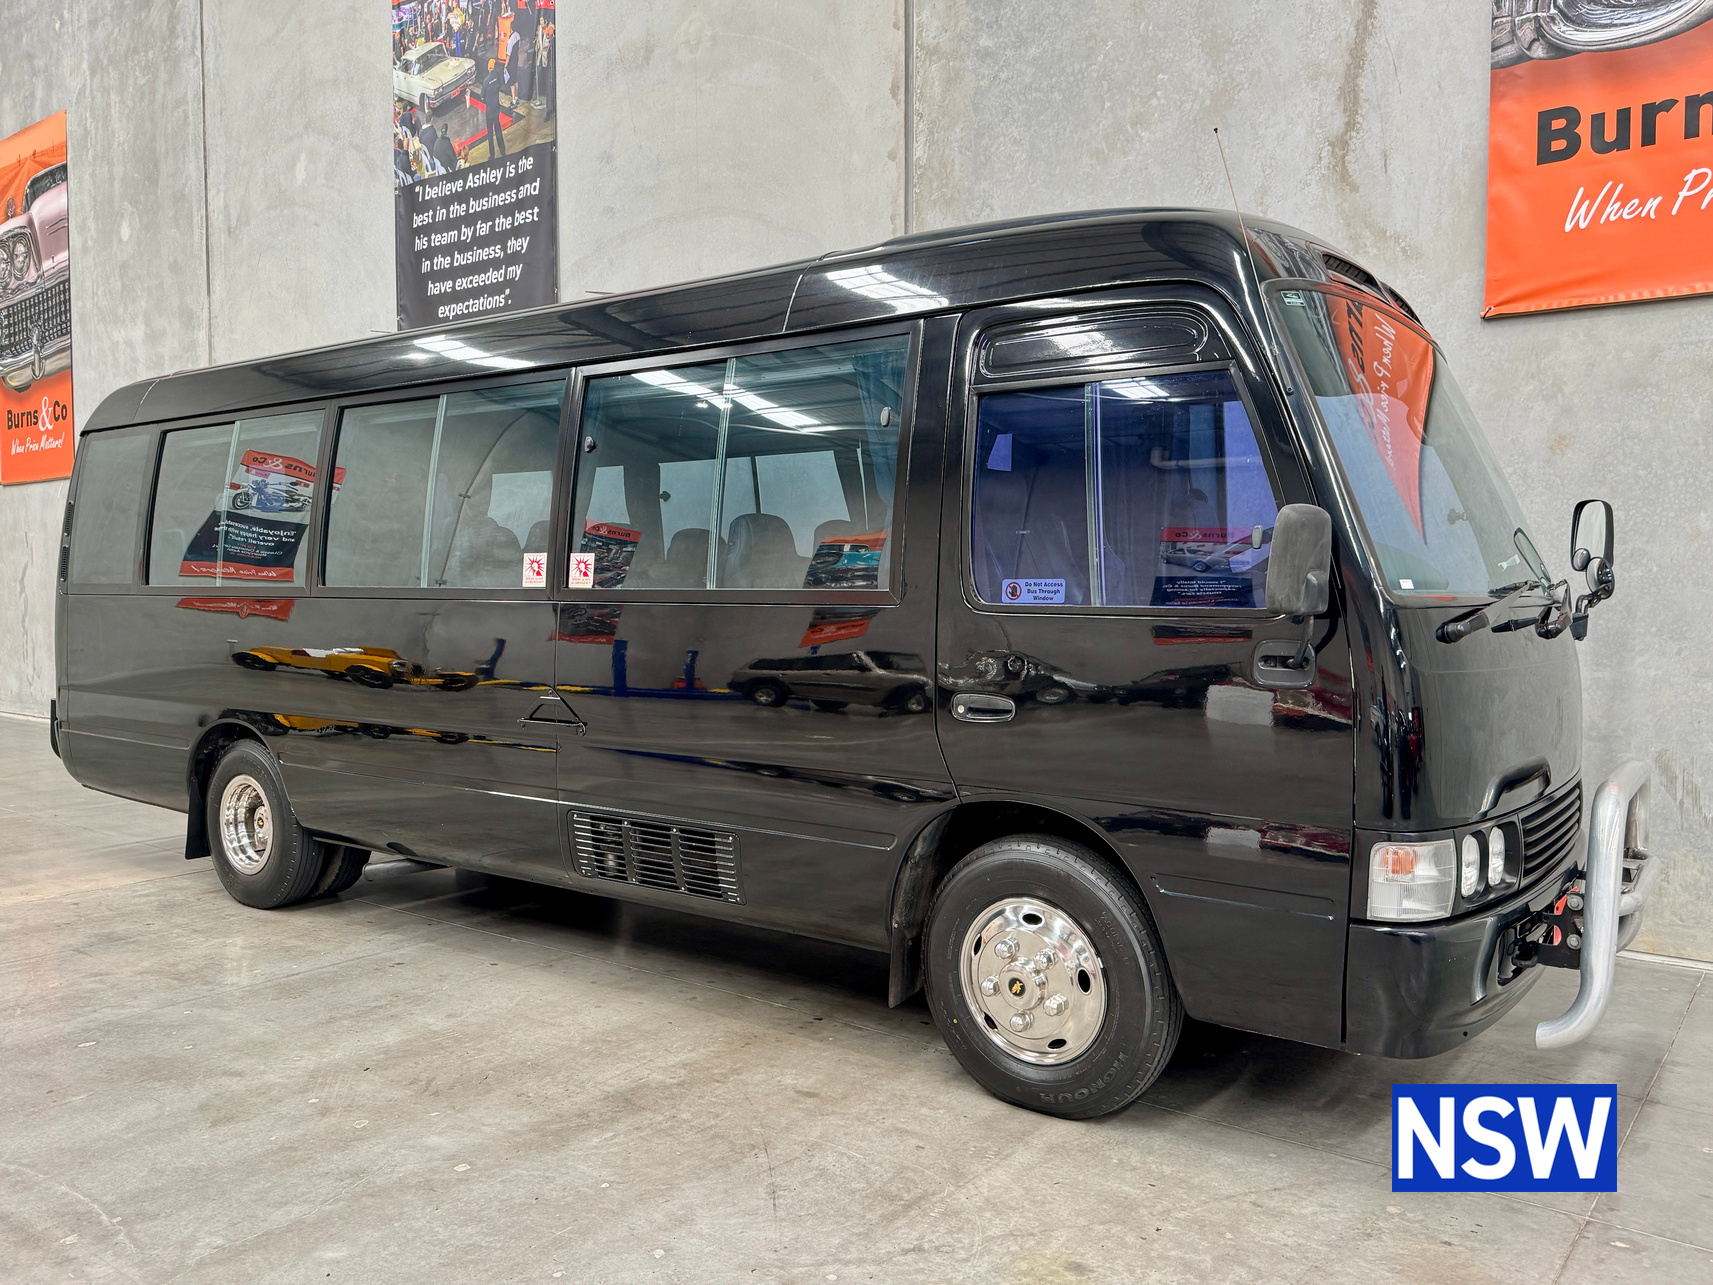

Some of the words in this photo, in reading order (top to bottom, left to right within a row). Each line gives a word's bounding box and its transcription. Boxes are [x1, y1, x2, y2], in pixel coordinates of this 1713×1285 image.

[425, 179, 463, 200] believe
[465, 168, 503, 190] Ashley
[505, 162, 515, 178] is
[518, 156, 534, 174] the
[413, 210, 433, 228] best
[436, 206, 446, 221] in
[449, 202, 466, 218] the
[469, 189, 516, 213] business
[518, 178, 540, 199] and
[1564, 180, 1663, 233] When
[415, 236, 428, 251] his
[431, 230, 458, 246] team
[461, 225, 474, 242] by
[476, 221, 492, 236] far
[495, 215, 512, 231] the
[514, 207, 539, 226] best
[422, 258, 430, 273] in
[434, 254, 450, 270] the
[454, 244, 504, 266] business,
[507, 236, 530, 254] they
[428, 281, 452, 296] have
[455, 265, 505, 290] exceeded
[507, 264, 523, 281] my
[11, 439, 24, 455] When
[25, 437, 39, 453] Price
[39, 432, 65, 451] Matters!
[1039, 1051, 1130, 1104] HONOUR
